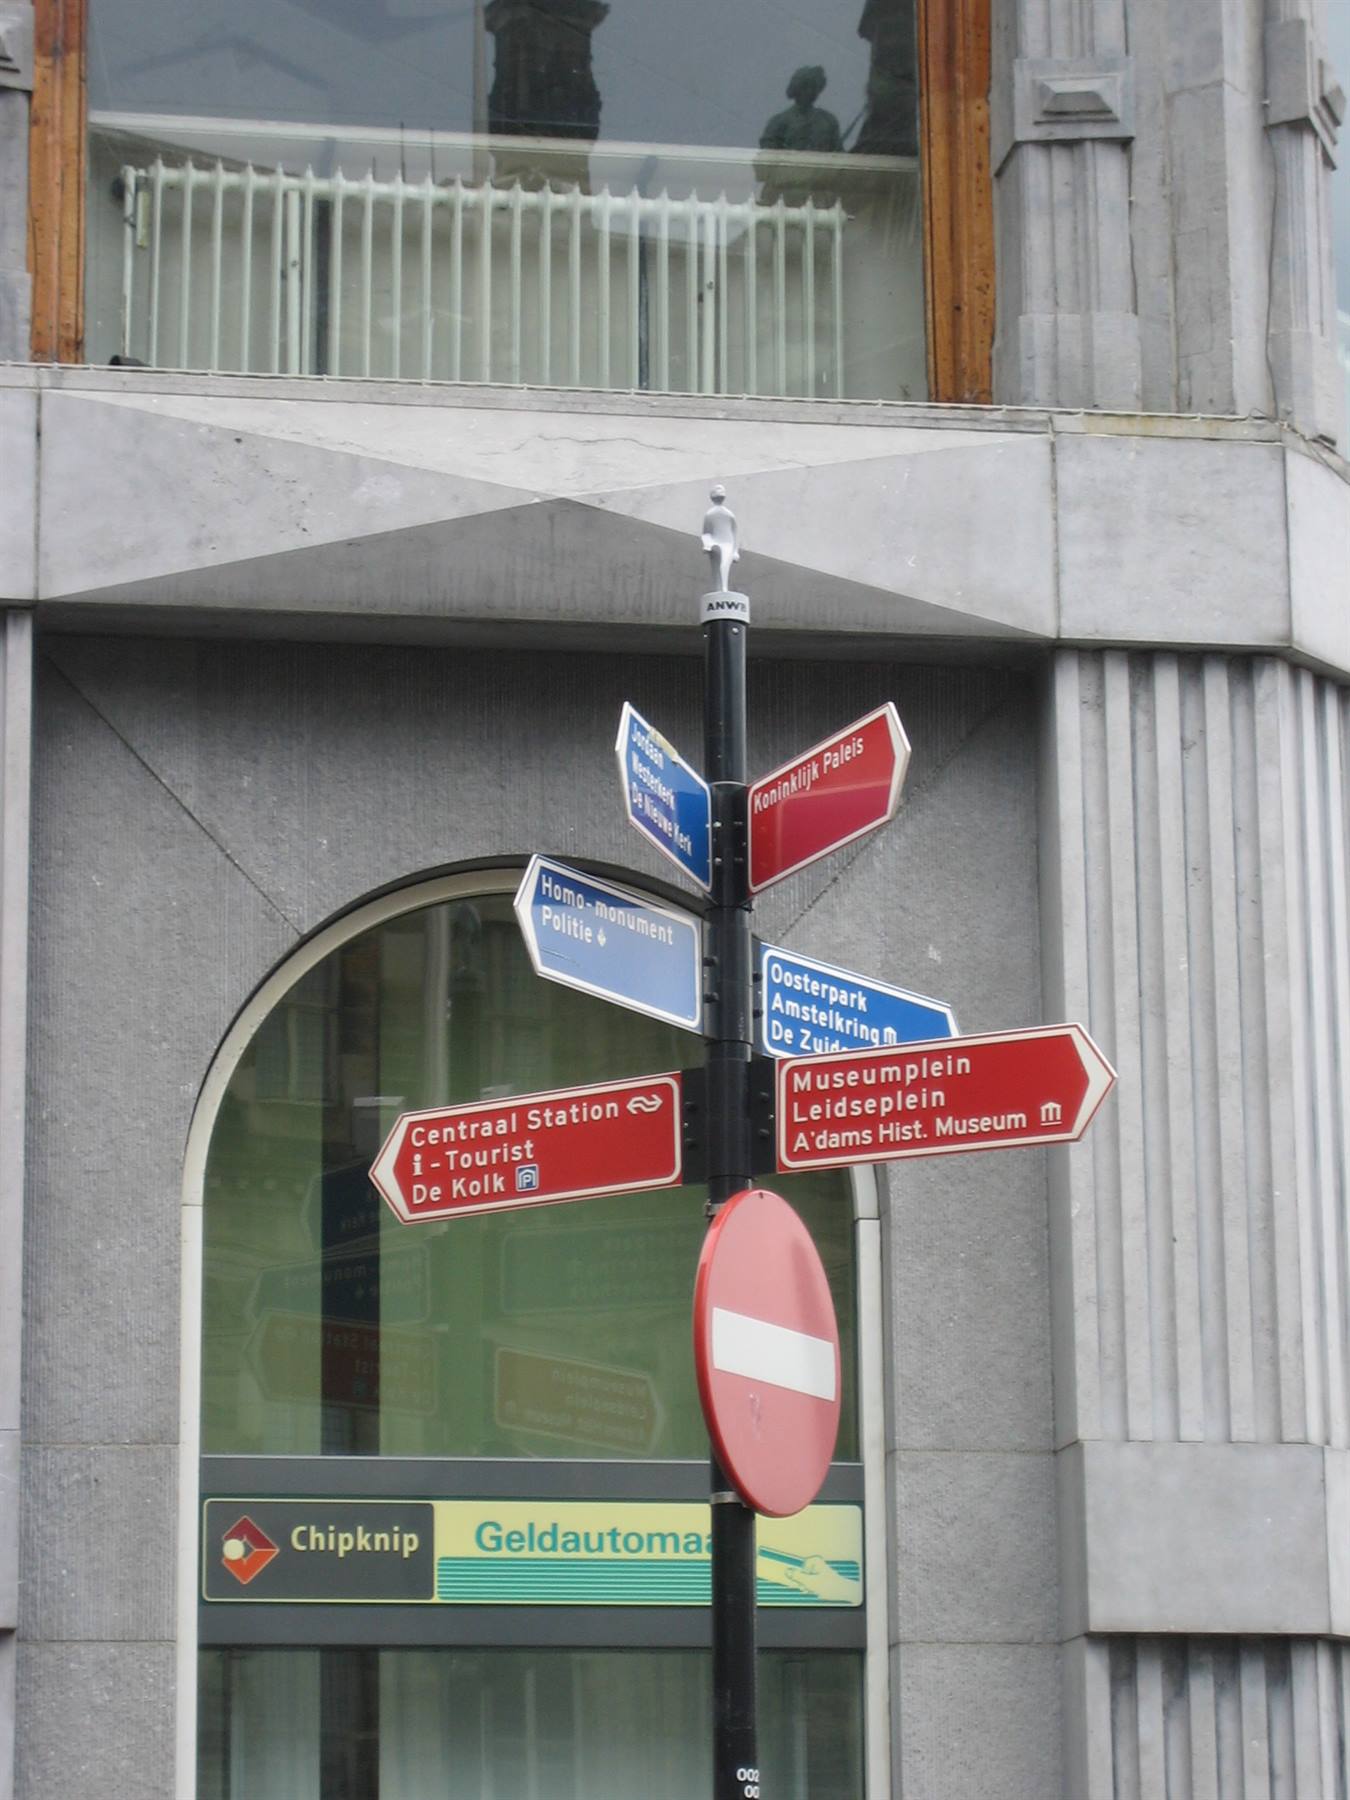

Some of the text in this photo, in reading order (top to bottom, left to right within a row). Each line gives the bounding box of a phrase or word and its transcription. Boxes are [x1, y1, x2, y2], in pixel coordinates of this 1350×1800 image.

[754, 737, 864, 813] Koninklijk Paleis
[541, 874, 673, 945] Homo-monument
[541, 905, 593, 943] Politie
[771, 963, 867, 1012] Oosterpark
[771, 993, 880, 1046] Amstelkring
[771, 1020, 849, 1053] De Zuid
[793, 1055, 971, 1093] Museumplein
[411, 1101, 619, 1148] Centraal Station
[793, 1089, 946, 1123] Leidseplein
[793, 1111, 1027, 1152] A'dams Hist. Museum
[412, 1184, 441, 1205] De
[452, 1174, 506, 1199] Kolk
[290, 1525, 420, 1558] Chipknip
[474, 1520, 712, 1554] Geldautoma
